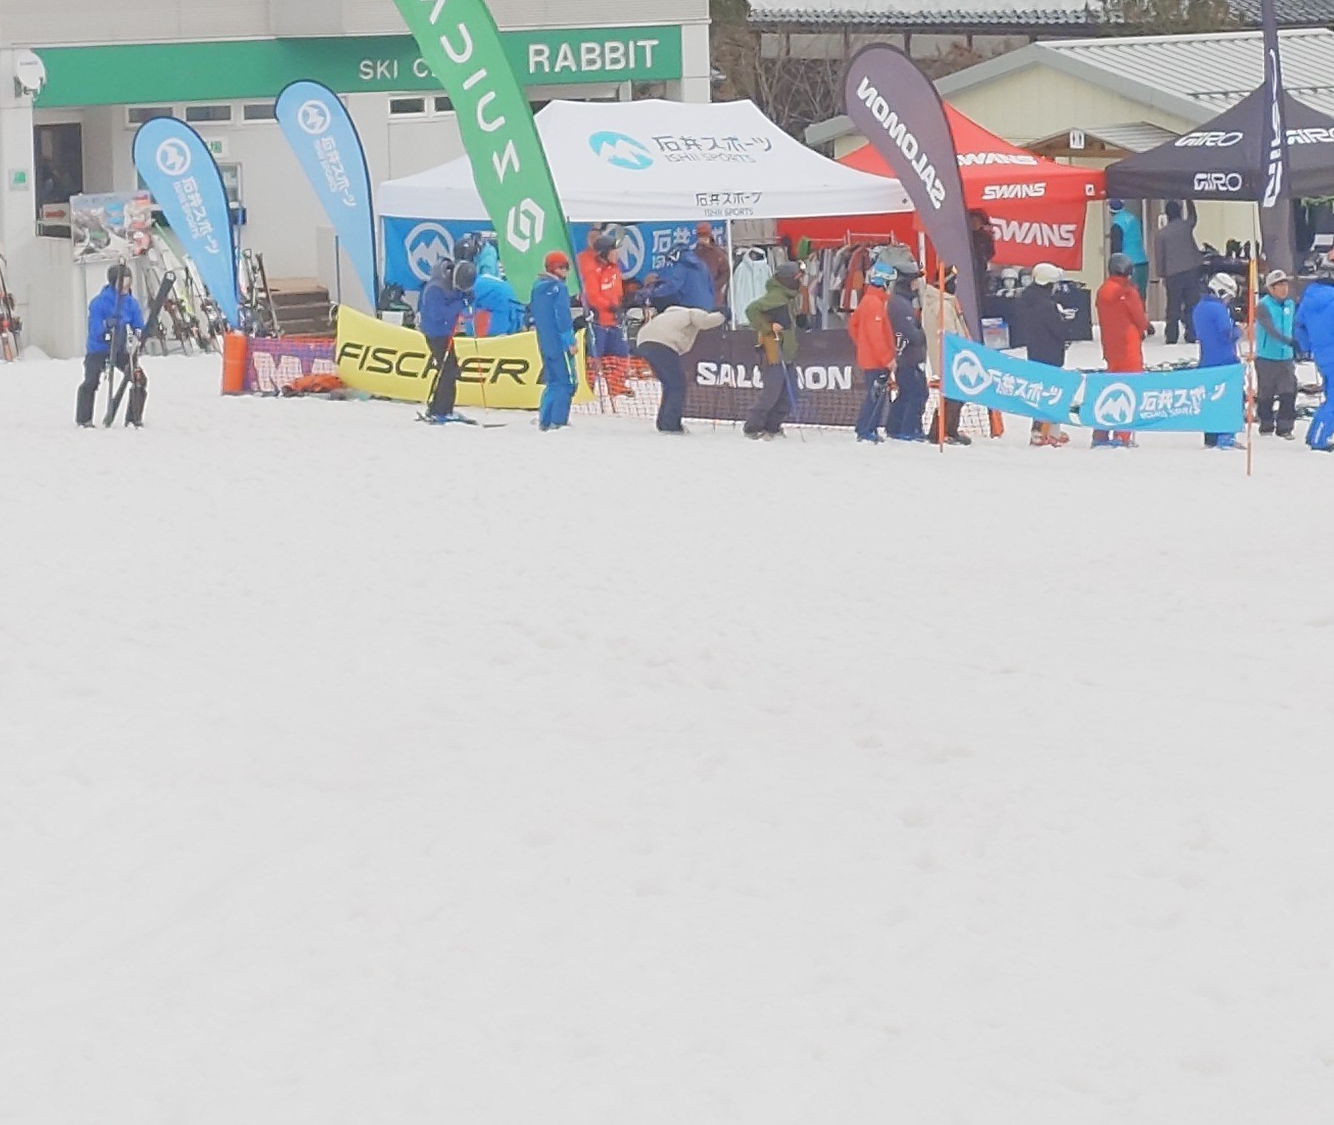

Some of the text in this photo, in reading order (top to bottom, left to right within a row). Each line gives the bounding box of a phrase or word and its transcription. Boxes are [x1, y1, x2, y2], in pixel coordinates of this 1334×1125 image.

[528, 39, 660, 74] RABBIT
[359, 59, 399, 80] SKI
[1174, 131, 1243, 147] GIRO
[981, 182, 1047, 200] SWANS
[1193, 172, 1243, 192] GIRO
